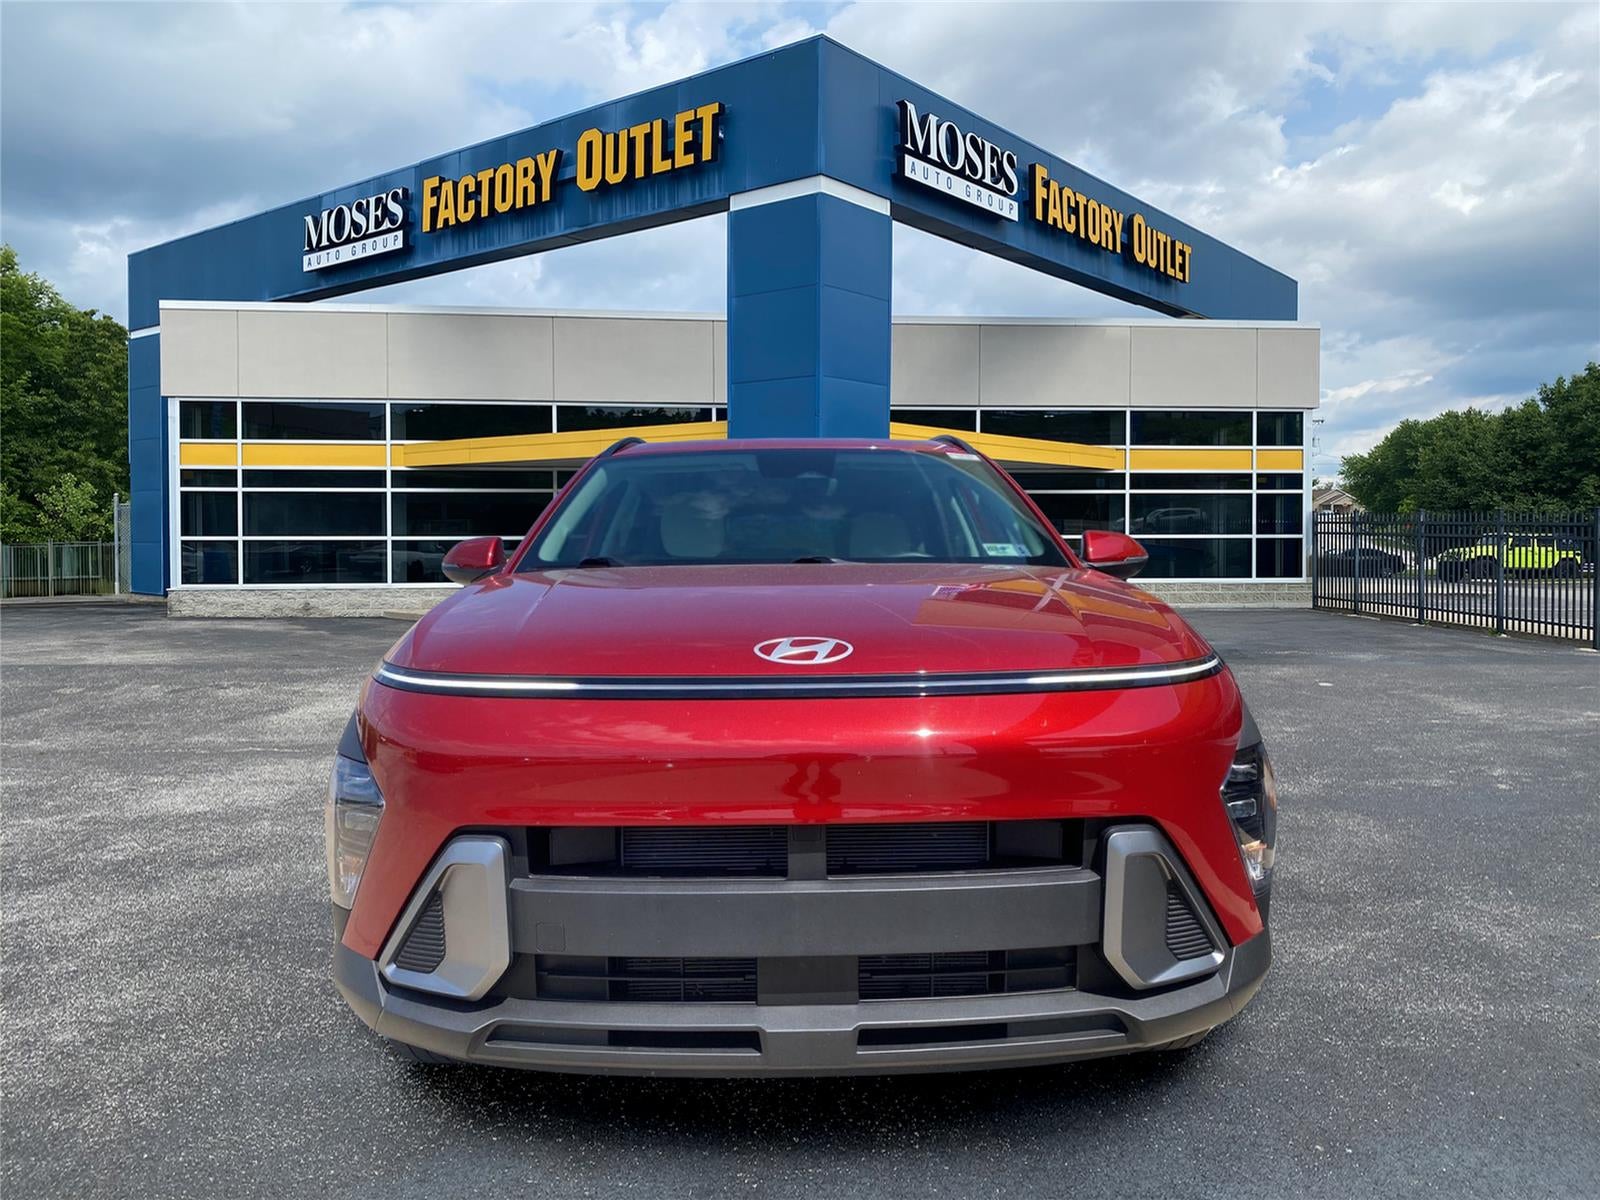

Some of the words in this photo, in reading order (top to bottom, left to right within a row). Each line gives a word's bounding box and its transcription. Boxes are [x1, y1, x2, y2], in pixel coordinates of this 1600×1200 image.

[422, 148, 558, 233] FACTORY
[576, 102, 721, 192] OUTLET
[904, 99, 1019, 197] MOSES
[910, 161, 952, 190] AUTO
[965, 184, 1014, 214] GROUP
[303, 187, 404, 252] MOSES
[307, 248, 341, 269] AUTO
[351, 234, 399, 258] GROUP
[1034, 163, 1124, 254] FACTORY
[1132, 212, 1192, 283] OUTLET
